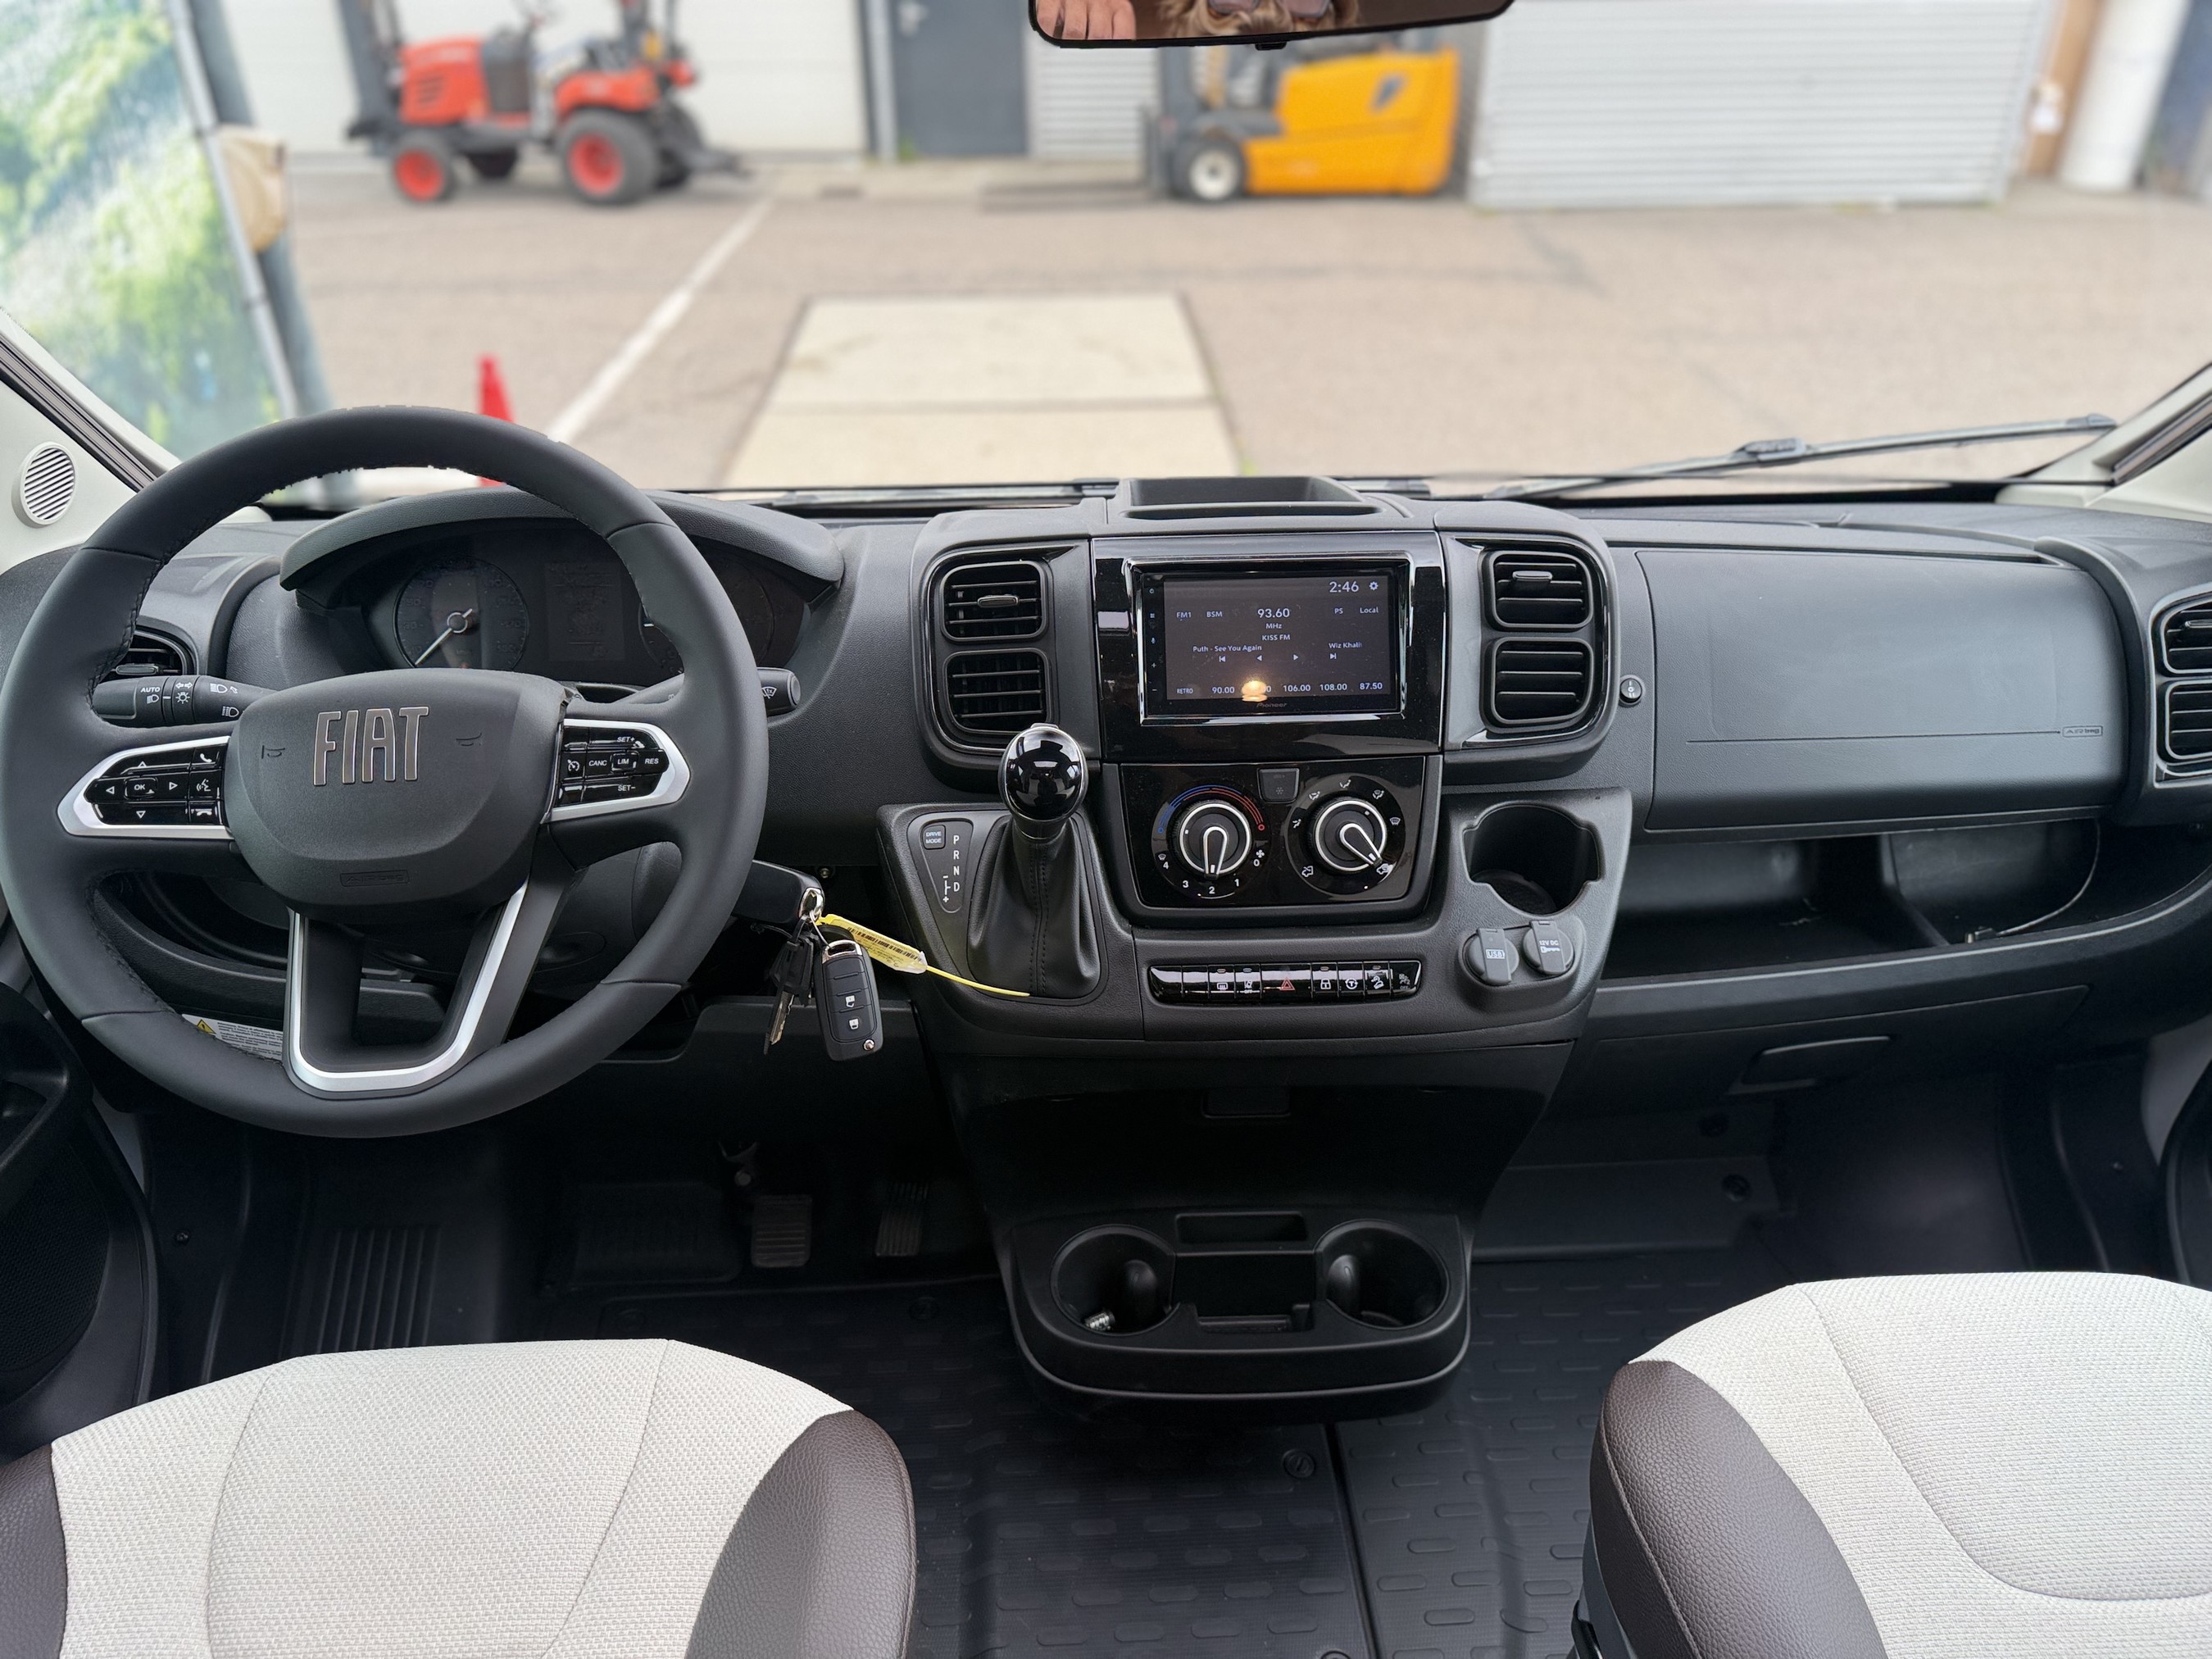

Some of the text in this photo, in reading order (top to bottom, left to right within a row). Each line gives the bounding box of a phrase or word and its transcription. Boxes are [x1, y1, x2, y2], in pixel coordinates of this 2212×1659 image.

[1329, 581, 1359, 593] 2:46
[1257, 607, 1290, 618] 93.60
[1242, 644, 1262, 652] Again
[314, 707, 429, 786] FIAT
[953, 835, 960, 844] P
[953, 850, 960, 860] R
[953, 866, 960, 875] N
[953, 882, 961, 892] D
[1234, 879, 1239, 887] 1
[1209, 886, 1215, 894] 2
